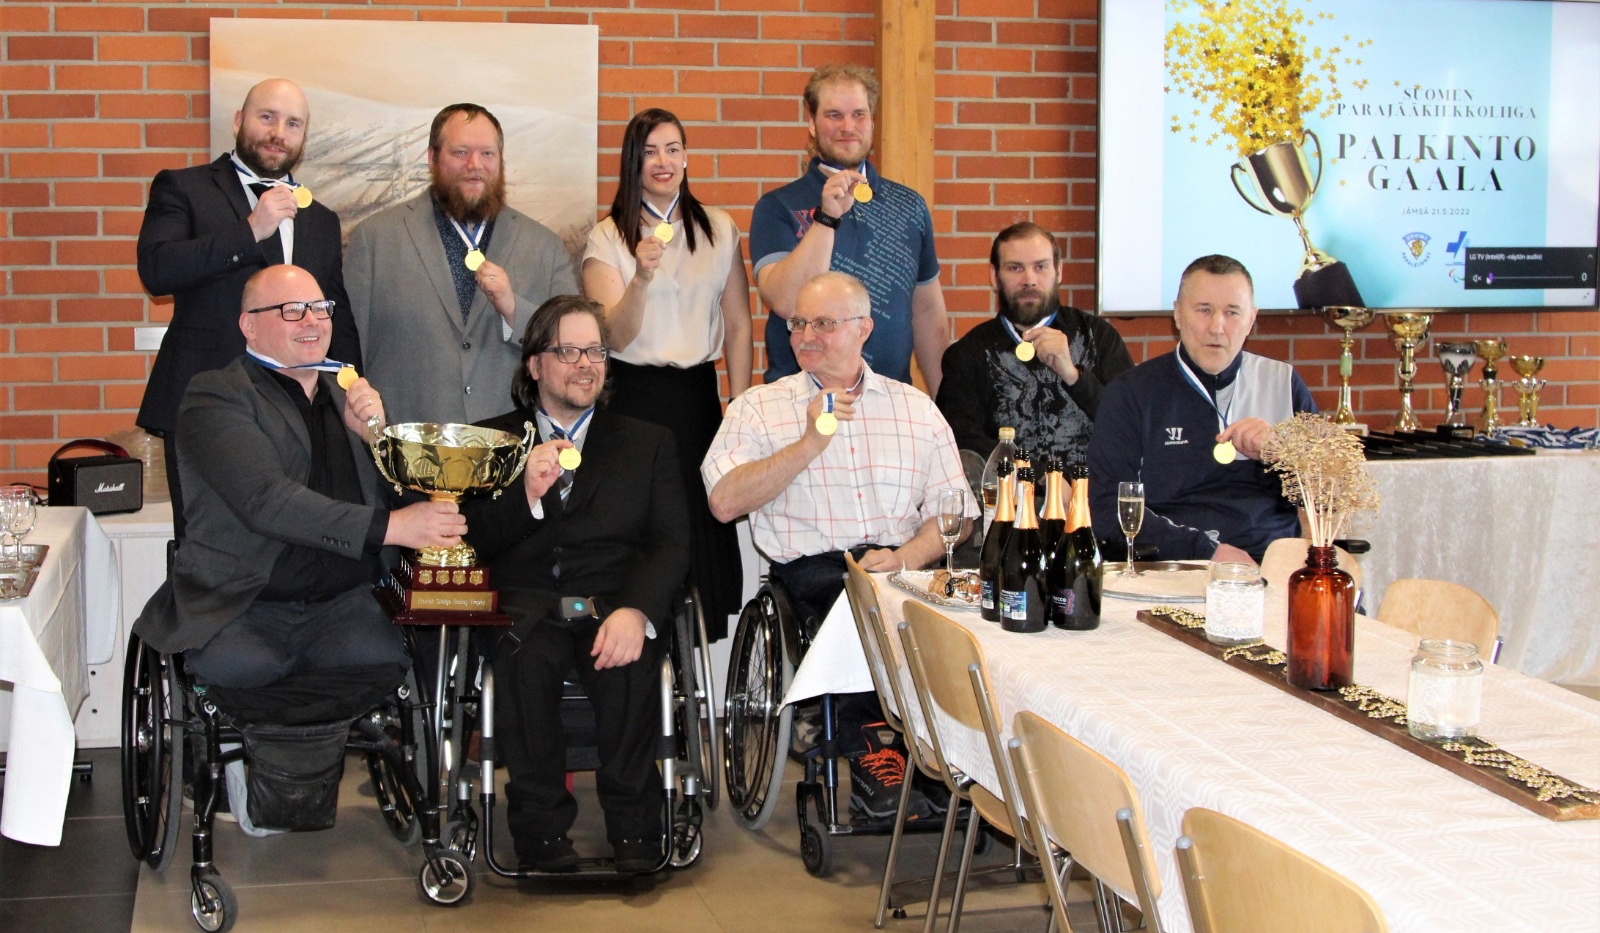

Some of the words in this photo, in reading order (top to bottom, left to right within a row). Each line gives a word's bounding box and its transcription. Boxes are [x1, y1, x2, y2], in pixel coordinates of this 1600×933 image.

[1403, 88, 1474, 101] SUOMEN
[1337, 102, 1537, 119] PARAJÄÄKIEKKOLIIGA
[1337, 133, 1537, 162] PALKINTO
[1367, 164, 1504, 191] GAALA
[1402, 206, 1429, 216] JÄMSÄ
[1431, 208, 1470, 216] 21.5.2022
[1469, 253, 1477, 261] LG
[1582, 272, 1588, 281] 0
[94, 482, 125, 493] Marshall
